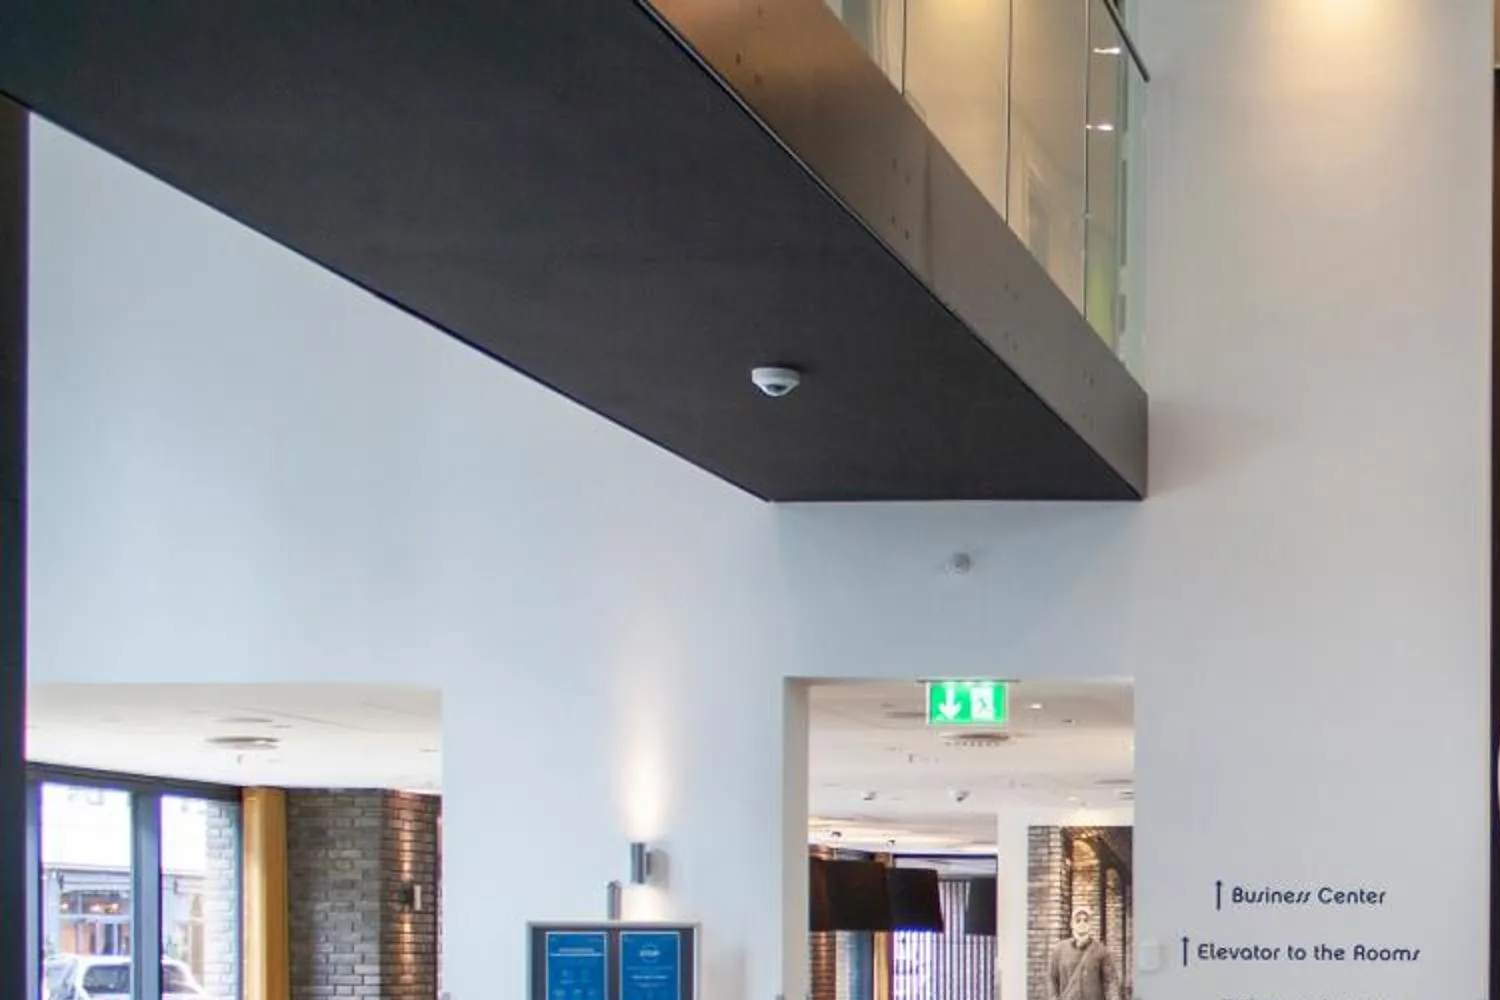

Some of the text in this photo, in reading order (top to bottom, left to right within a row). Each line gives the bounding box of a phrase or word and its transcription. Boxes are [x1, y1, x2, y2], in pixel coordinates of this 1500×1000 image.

[1231, 885, 1387, 905] Business Center
[1197, 942, 1421, 962] Elevator to the Rooms
